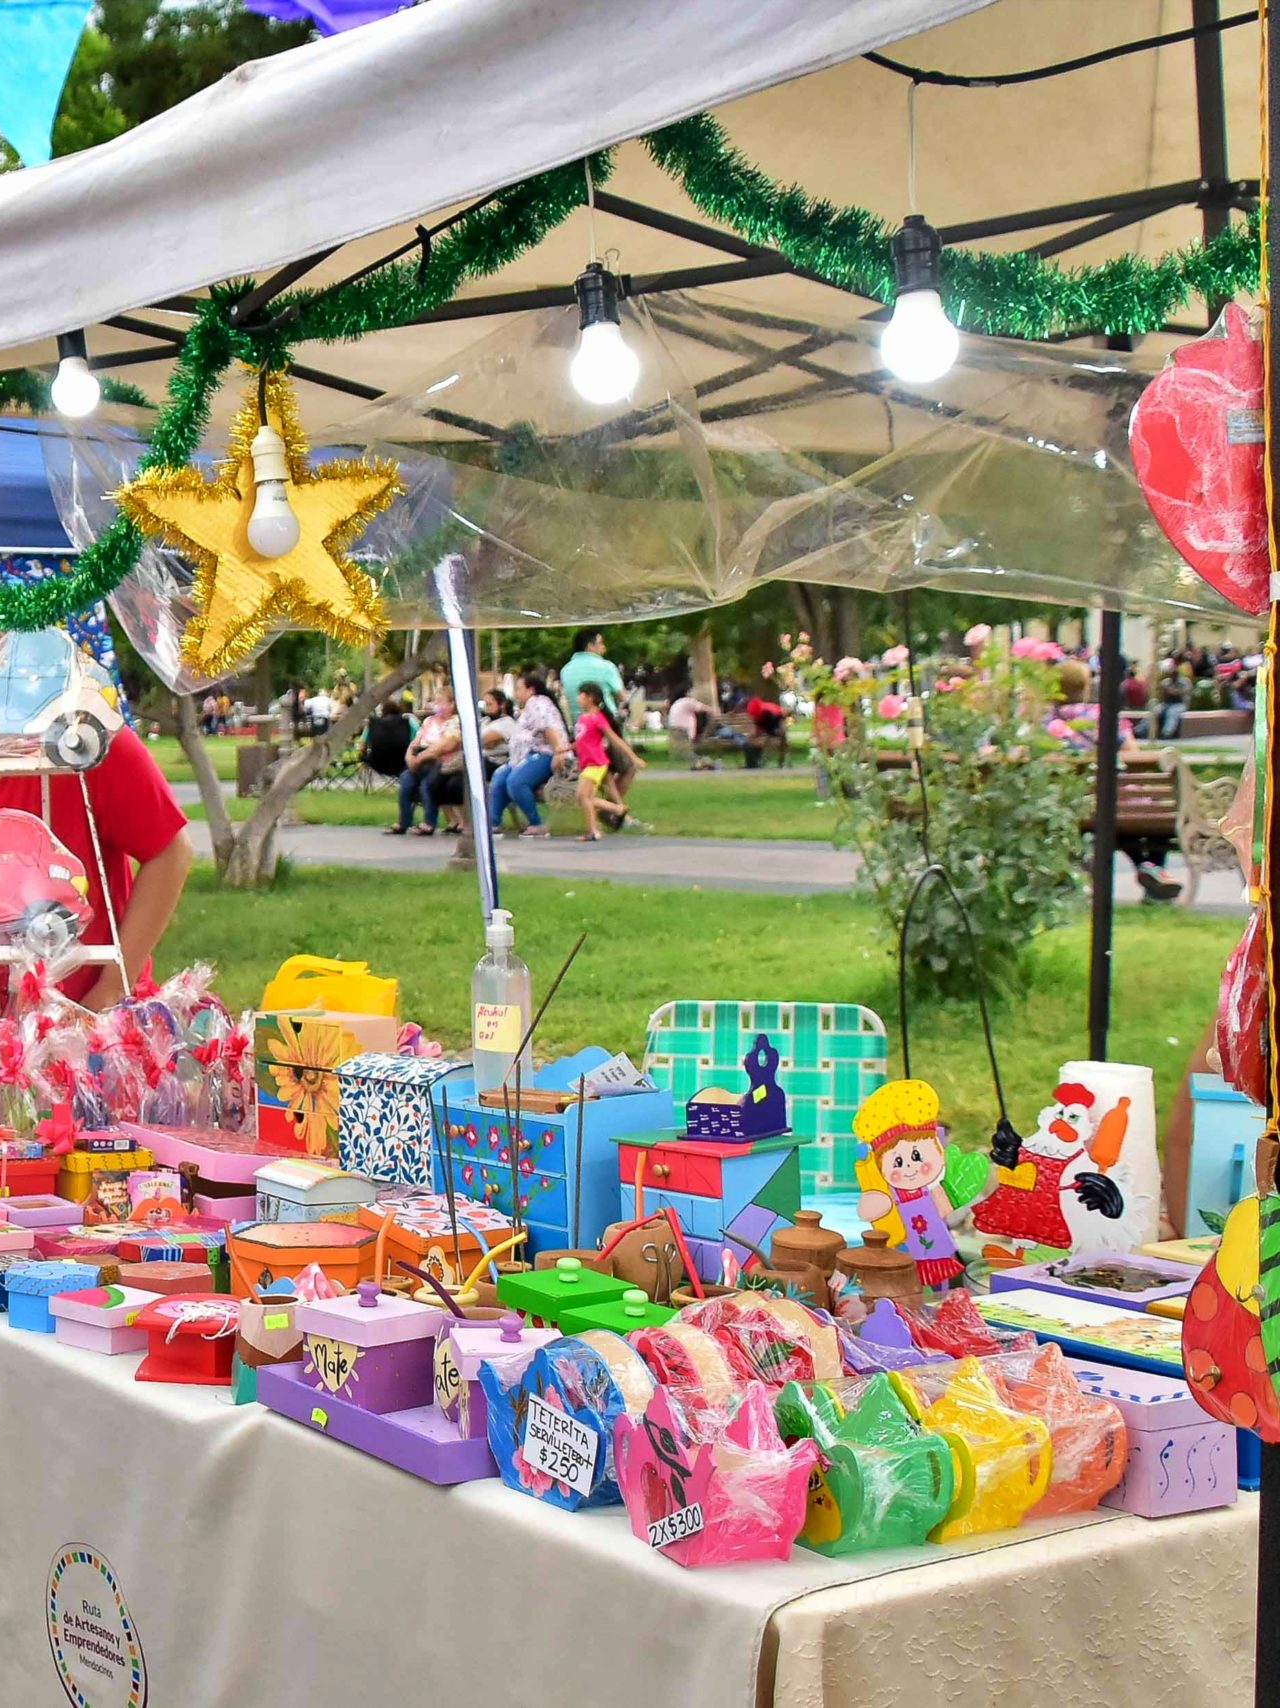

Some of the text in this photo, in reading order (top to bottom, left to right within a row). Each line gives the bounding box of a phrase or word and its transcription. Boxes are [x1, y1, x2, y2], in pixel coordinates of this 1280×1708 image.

[314, 1343, 348, 1387] Mate
[435, 1352, 460, 1398] ate
[529, 1399, 589, 1449] TETERITA
[540, 1446, 578, 1482] $250
[63, 1611, 73, 1626] de
[75, 1616, 114, 1644] Artesanos
[82, 1600, 101, 1618] Ruta
[64, 1628, 125, 1666] Emprendedores
[79, 1654, 113, 1679] Mendocinos
